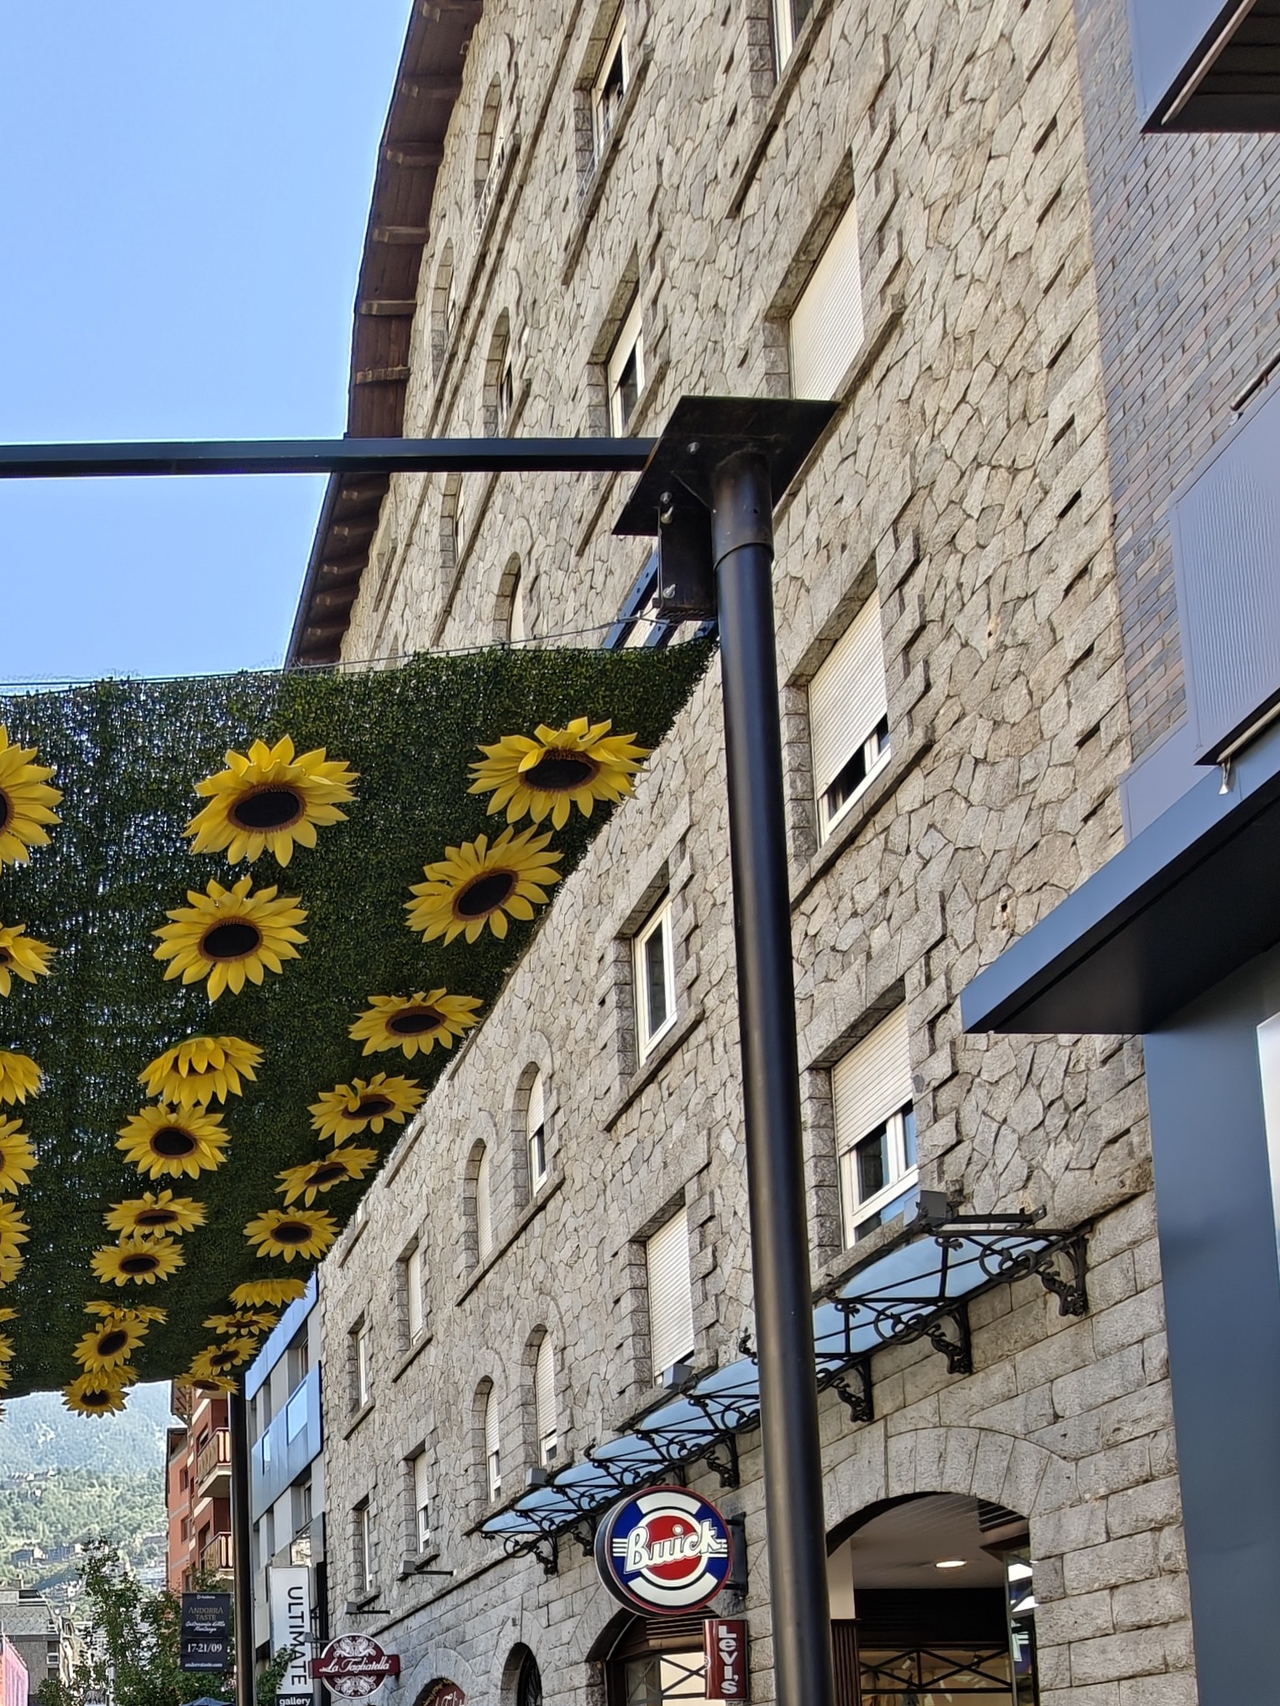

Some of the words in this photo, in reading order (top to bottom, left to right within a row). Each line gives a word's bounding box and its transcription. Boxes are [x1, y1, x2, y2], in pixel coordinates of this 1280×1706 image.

[624, 1518, 721, 1575] Buick
[287, 1586, 308, 1686] ULTIMATE
[187, 1643, 223, 1653] 17-21/09
[319, 1659, 338, 1673] La
[339, 1656, 390, 1673] Tagliatella
[279, 1696, 311, 1706] gallery
